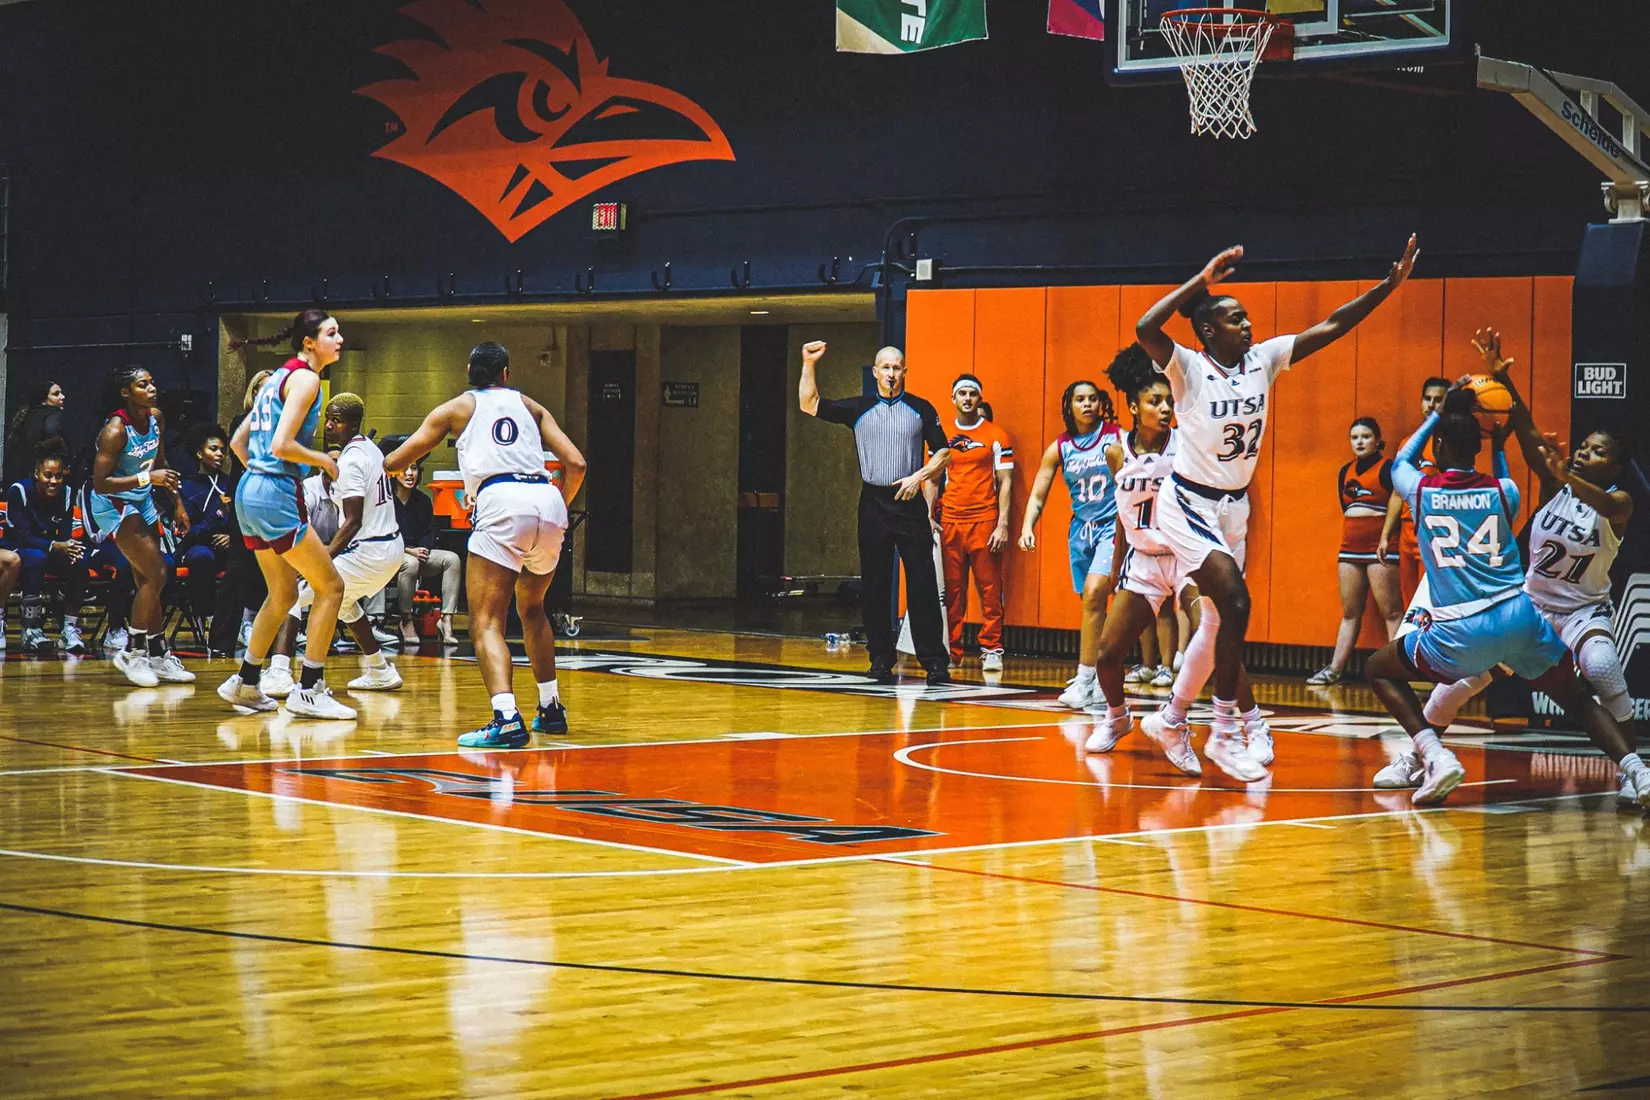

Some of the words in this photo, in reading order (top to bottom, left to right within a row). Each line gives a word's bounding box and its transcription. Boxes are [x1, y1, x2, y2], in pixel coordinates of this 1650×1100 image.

[1577, 381, 1622, 394] LIGHT
[1584, 367, 1616, 380] BUD
[1209, 393, 1265, 419] UTSA
[492, 416, 519, 446] 0
[1217, 418, 1262, 462] 32
[1076, 473, 1107, 503] 10
[1121, 476, 1165, 492] UTS
[1431, 494, 1491, 510] BRANNON
[1424, 514, 1504, 568] 24
[1540, 510, 1601, 547] UTSA
[1533, 539, 1596, 585] 21
